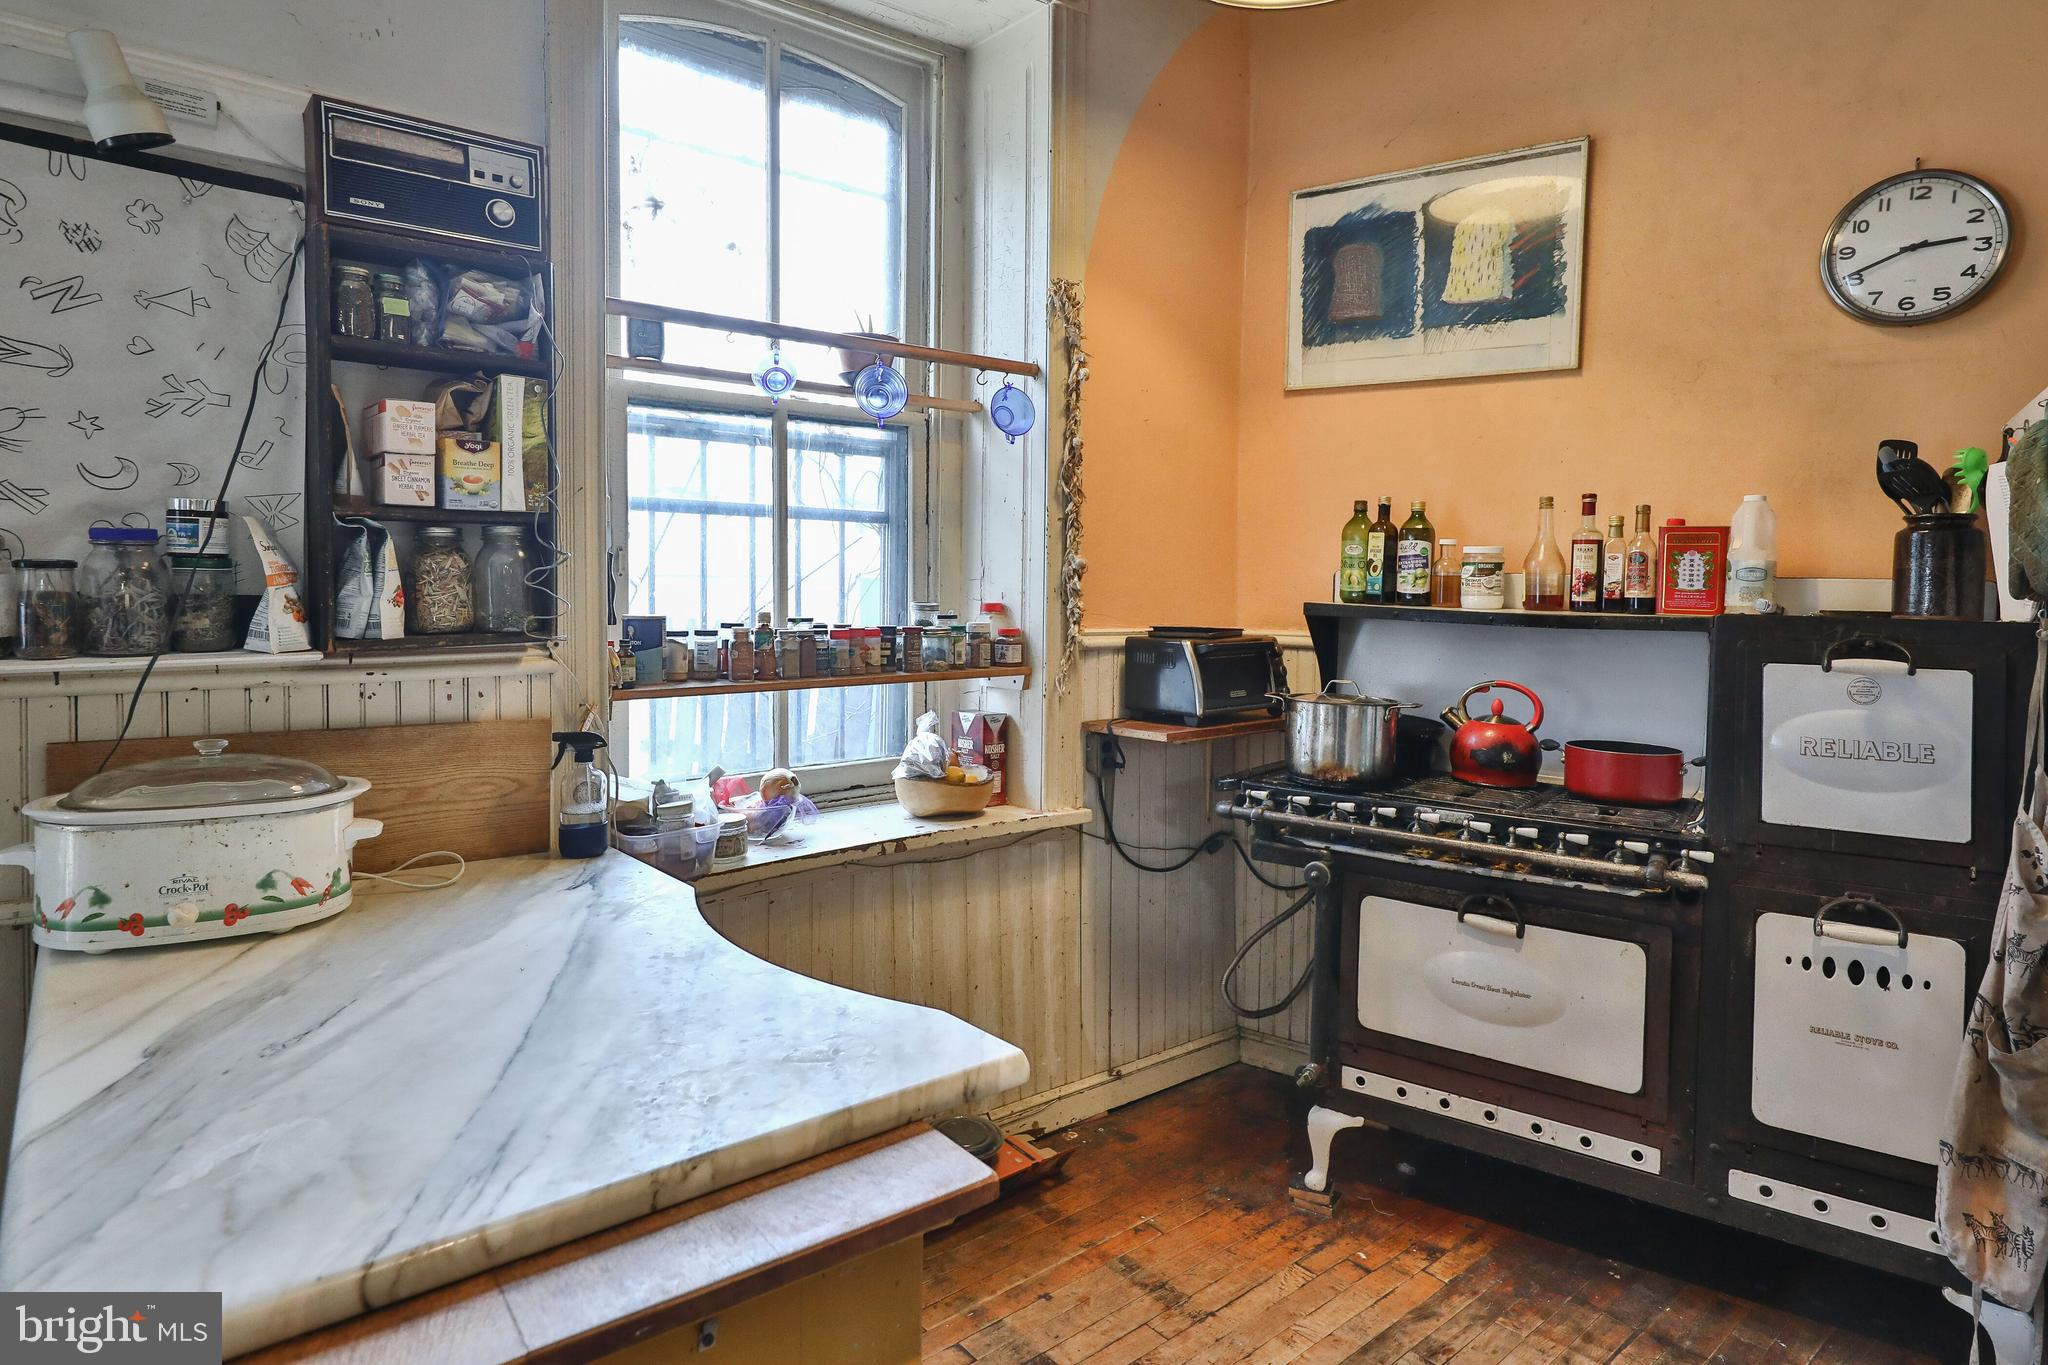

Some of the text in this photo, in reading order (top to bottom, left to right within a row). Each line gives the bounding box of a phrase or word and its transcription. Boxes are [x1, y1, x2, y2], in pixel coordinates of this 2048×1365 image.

[1910, 186, 1933, 200] 12
[1952, 189, 1957, 204] 1
[352, 198, 381, 207] SONY
[1878, 198, 1891, 212] 11
[1966, 209, 1986, 223] 2
[1852, 219, 1870, 234] 10
[1973, 236, 1993, 252] 3
[1838, 246, 1856, 260] 9
[1960, 264, 1978, 278] 4
[1845, 272, 1864, 286] 8
[1868, 291, 1884, 305] 7
[1932, 287, 1951, 301] 5
[1898, 296, 1916, 311] 6
[506, 382, 514, 398] TEA
[507, 423, 515, 458] ORGANIC
[452, 459, 477, 467] Breathe
[478, 461, 495, 470] Deep
[507, 459, 515, 477] 100%
[984, 743, 1006, 755] KOSHER
[1799, 736, 1936, 764] RELIABLE
[1808, 1025, 1851, 1041] RELIABLE
[1853, 1034, 1884, 1047] STOVE
[1885, 1041, 1899, 1051] CO.
